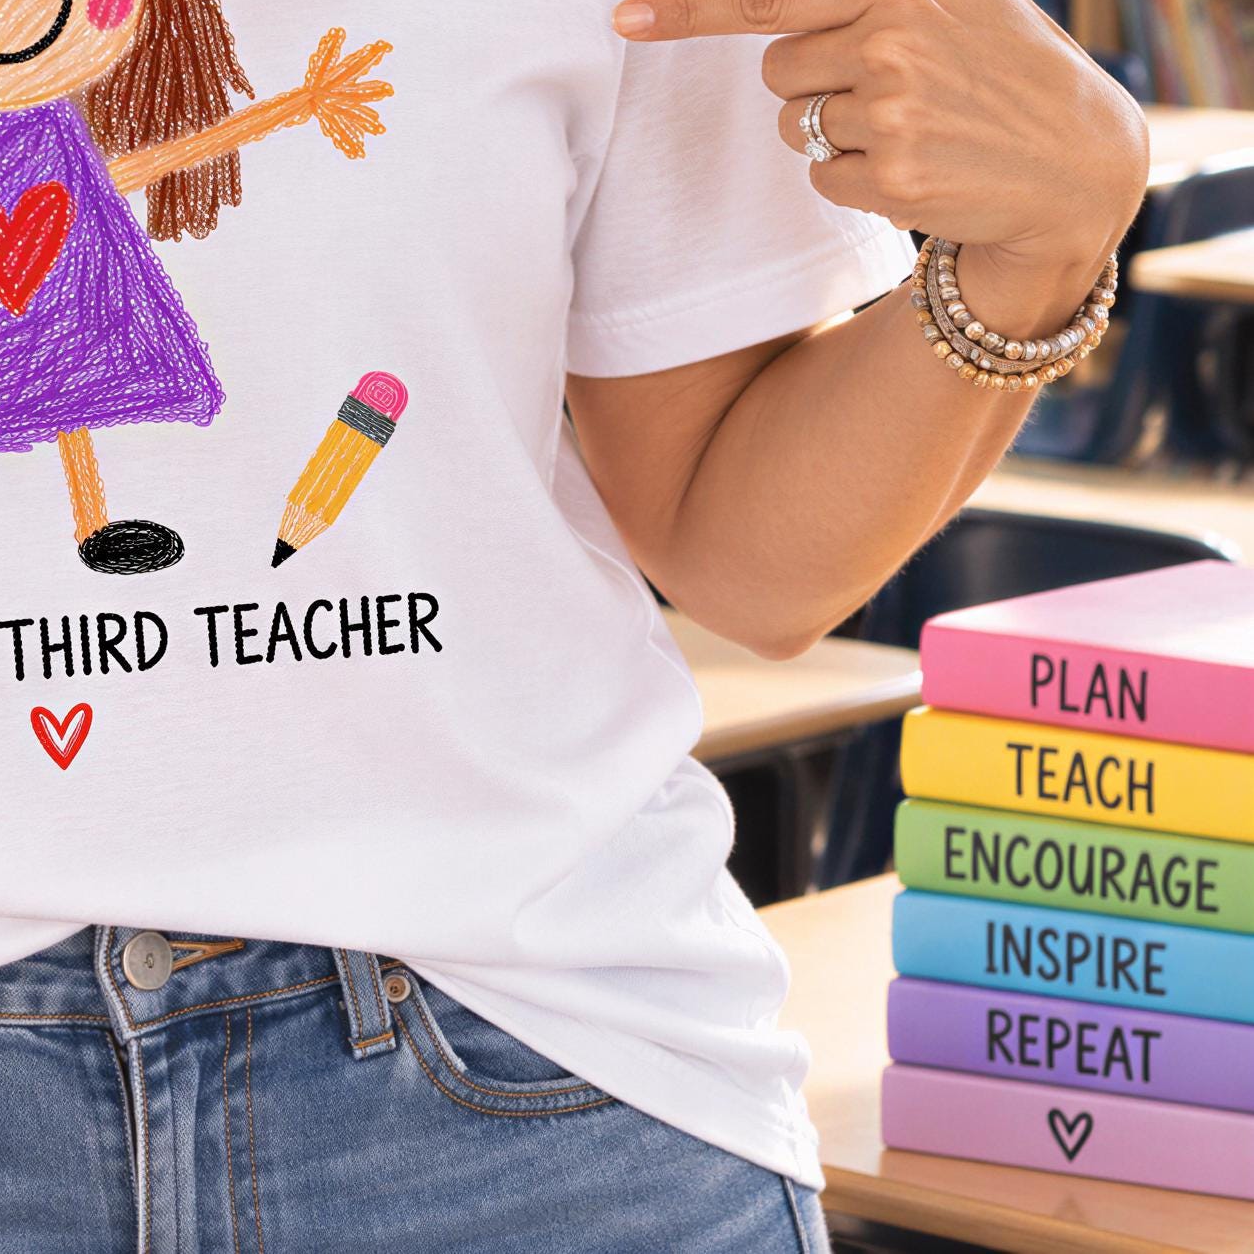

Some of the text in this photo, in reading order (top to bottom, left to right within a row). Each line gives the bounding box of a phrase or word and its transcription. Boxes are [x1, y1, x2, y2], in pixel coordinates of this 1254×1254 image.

[194, 593, 442, 667] TEACHER
[1029, 654, 1149, 723] PLAN
[1006, 743, 1156, 814] TEACH
[943, 827, 1220, 914] ENCOURAGE
[985, 921, 1167, 996] INSPIRE
[986, 1009, 1162, 1084] REPEAT
